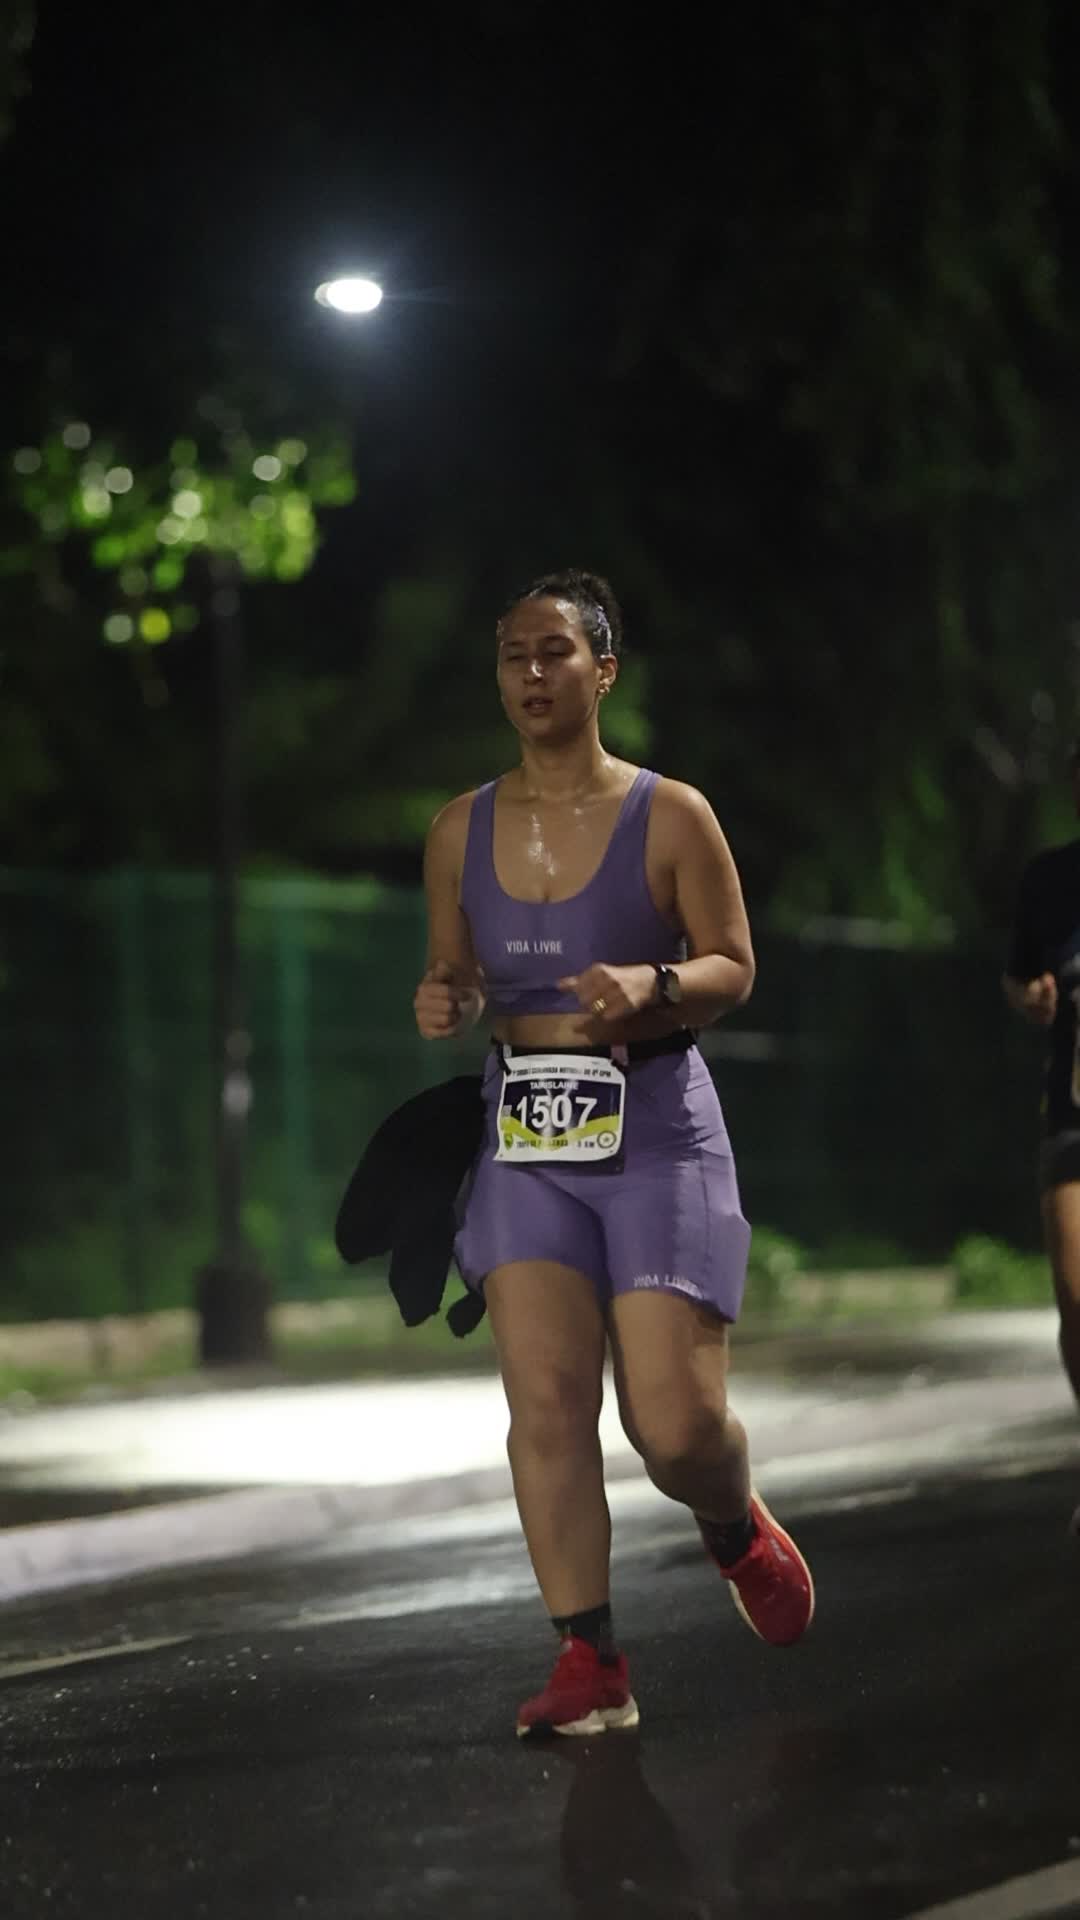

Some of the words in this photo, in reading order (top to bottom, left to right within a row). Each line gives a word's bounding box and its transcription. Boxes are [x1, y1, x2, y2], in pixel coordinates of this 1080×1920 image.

[506, 940, 530, 953] VIDA
[534, 940, 562, 954] LIVRE
[516, 1094, 597, 1129] 1507
